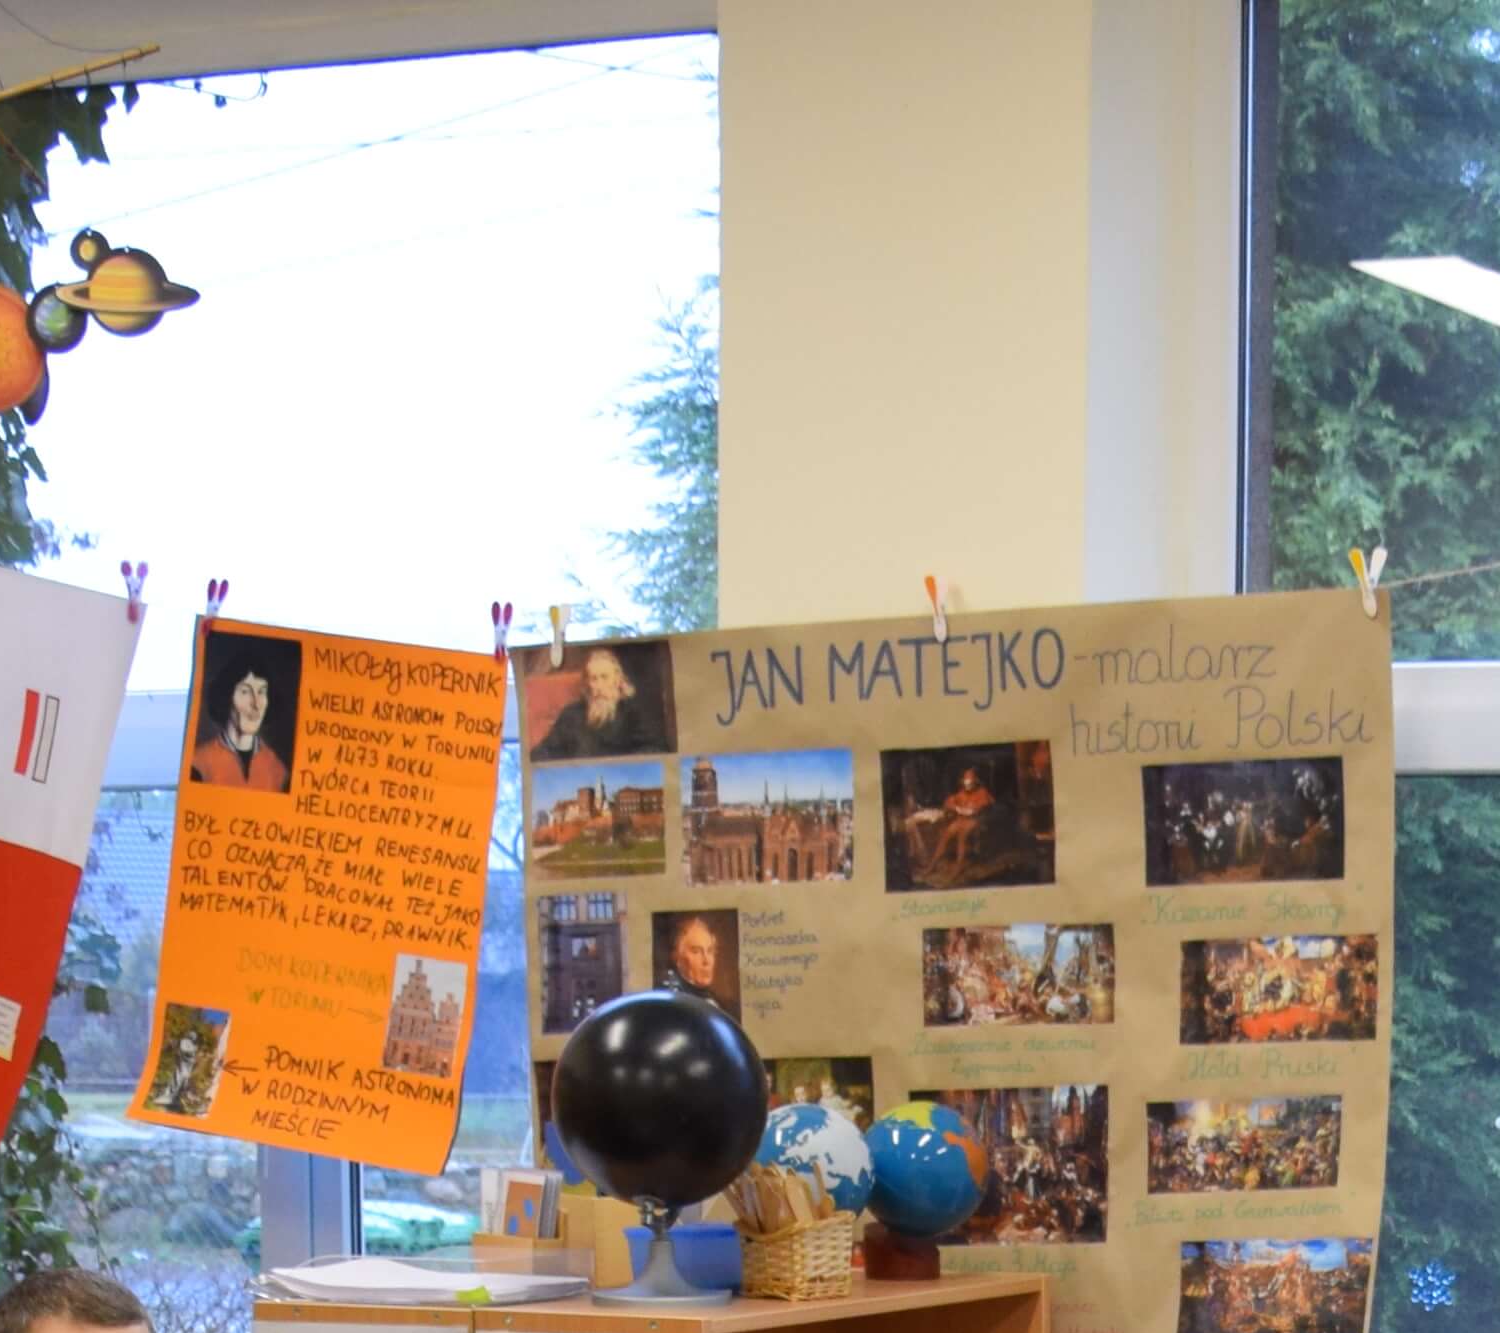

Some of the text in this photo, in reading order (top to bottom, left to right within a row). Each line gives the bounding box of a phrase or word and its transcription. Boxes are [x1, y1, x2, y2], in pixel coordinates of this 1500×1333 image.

[406, 660, 502, 698] KOPERNIK
[711, 646, 804, 727] JAN
[828, 627, 1066, 712] MATEJKO
[308, 688, 364, 716] WIELKI
[371, 700, 445, 727] ASTRONOM
[1223, 684, 1374, 750] Polski
[14, 688, 60, 783] II
[305, 719, 496, 765] URODZONY W TORUNIU
[307, 747, 323, 764] W
[335, 743, 379, 768] 1473
[299, 767, 435, 802] TWÓRCA TEORII
[184, 809, 481, 875] BYŁ CZŁOWIEKIEM RENESANSU
[187, 838, 213, 861] CO
[344, 860, 385, 887] MIAŁ
[402, 869, 463, 898] WIELE
[264, 1044, 455, 1109] POMNIK ASTRONOMA
[241, 1077, 390, 1125] W RODZINNYM
[251, 1105, 342, 1141] MIEŚCIE
